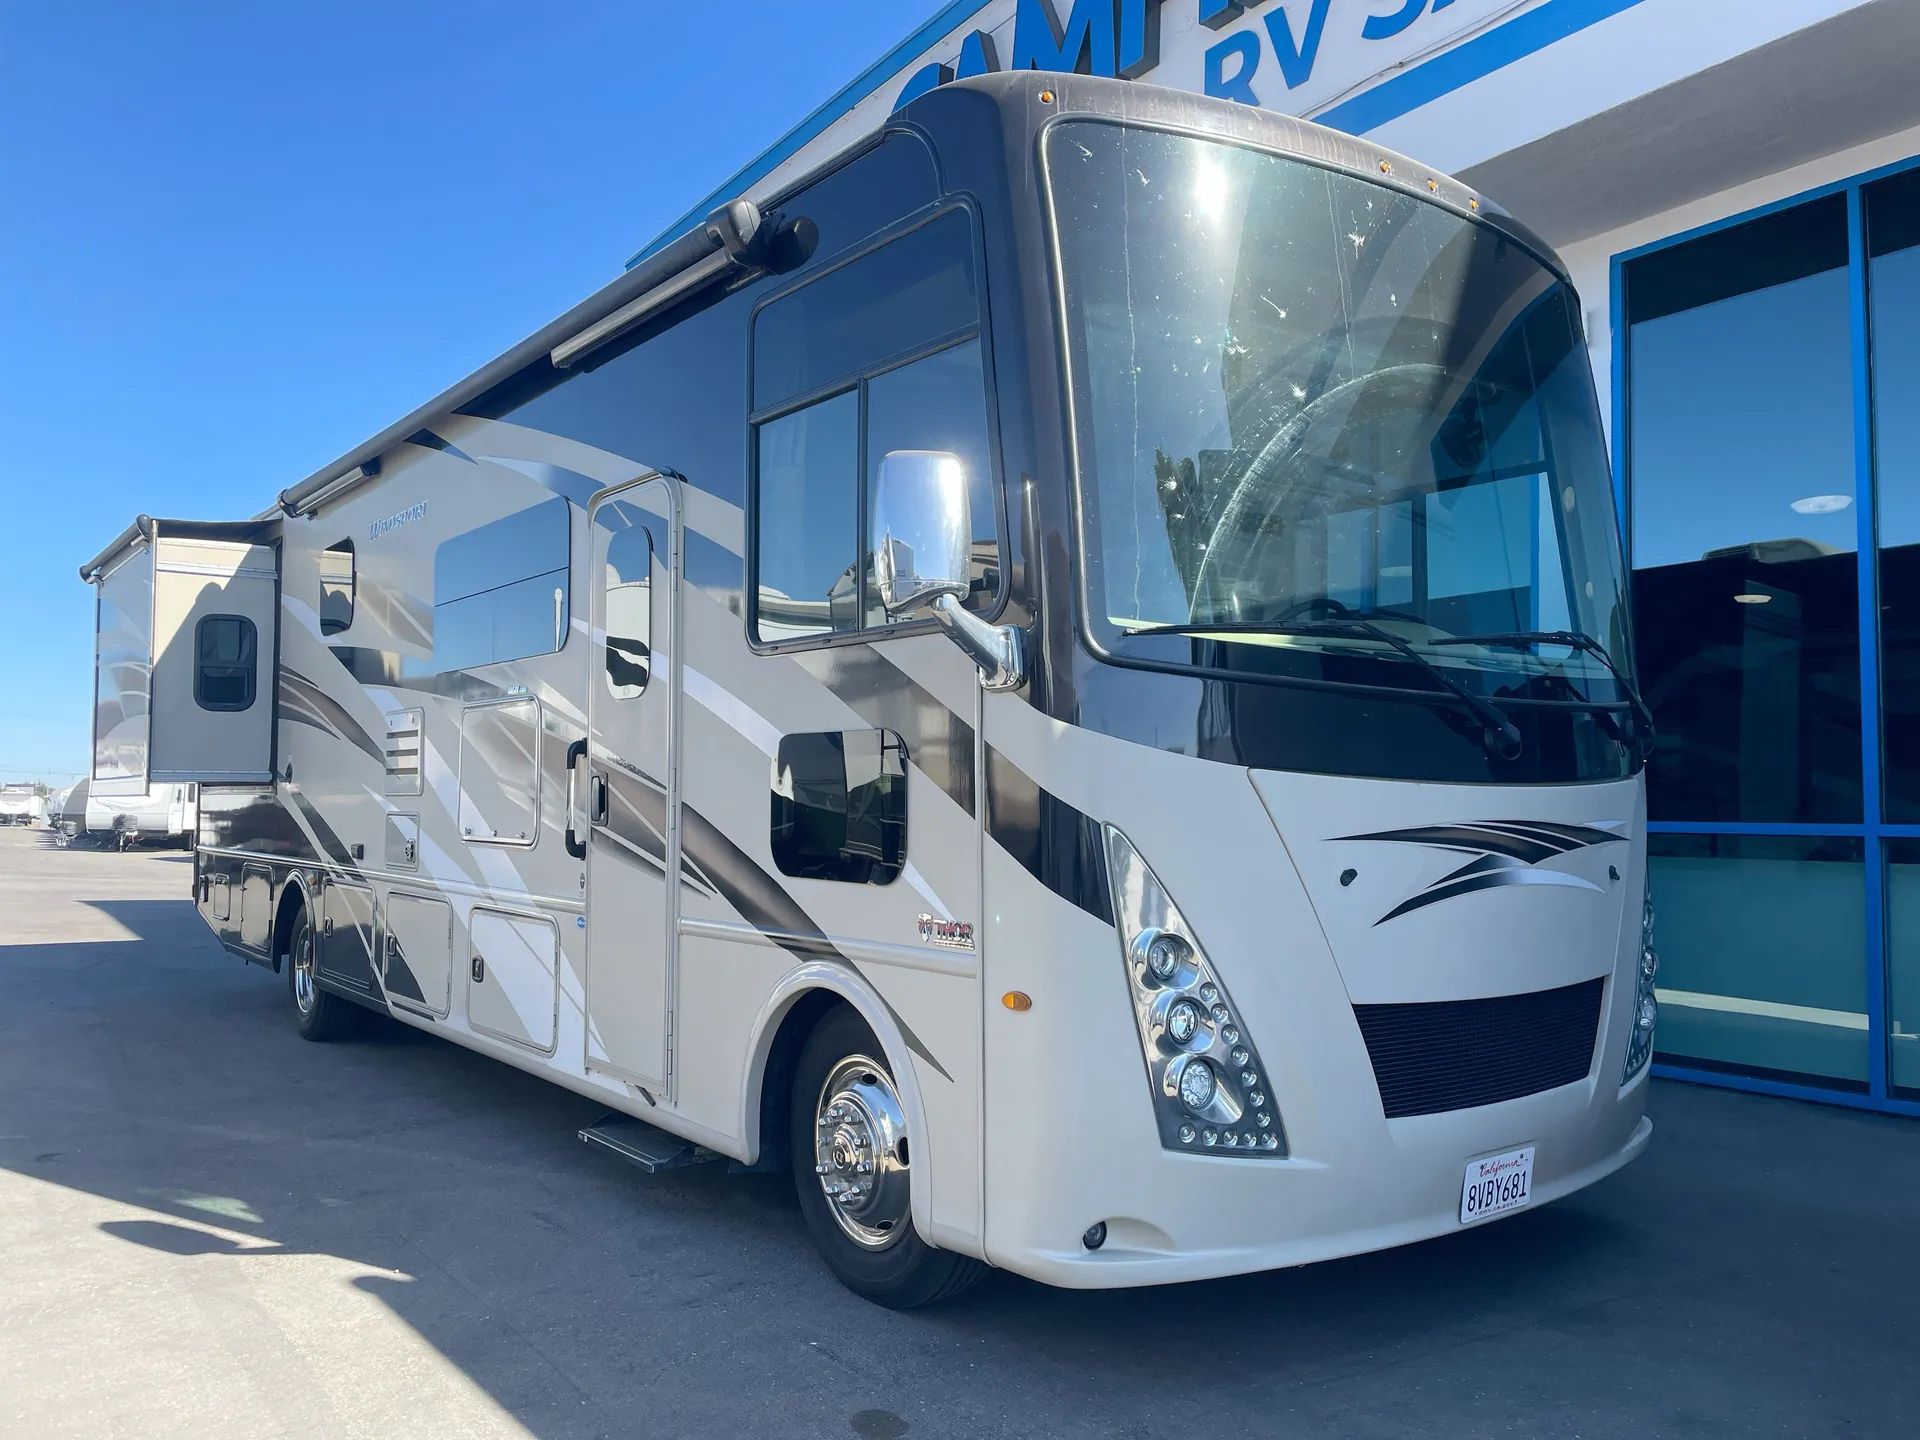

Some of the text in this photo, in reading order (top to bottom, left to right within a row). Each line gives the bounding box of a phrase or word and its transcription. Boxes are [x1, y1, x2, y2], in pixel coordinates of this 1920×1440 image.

[1204, 0, 1331, 107] RV
[933, 920, 973, 943] THOR
[1480, 1160, 1521, 1177] California
[1467, 1170, 1526, 1213] 8VBY681
